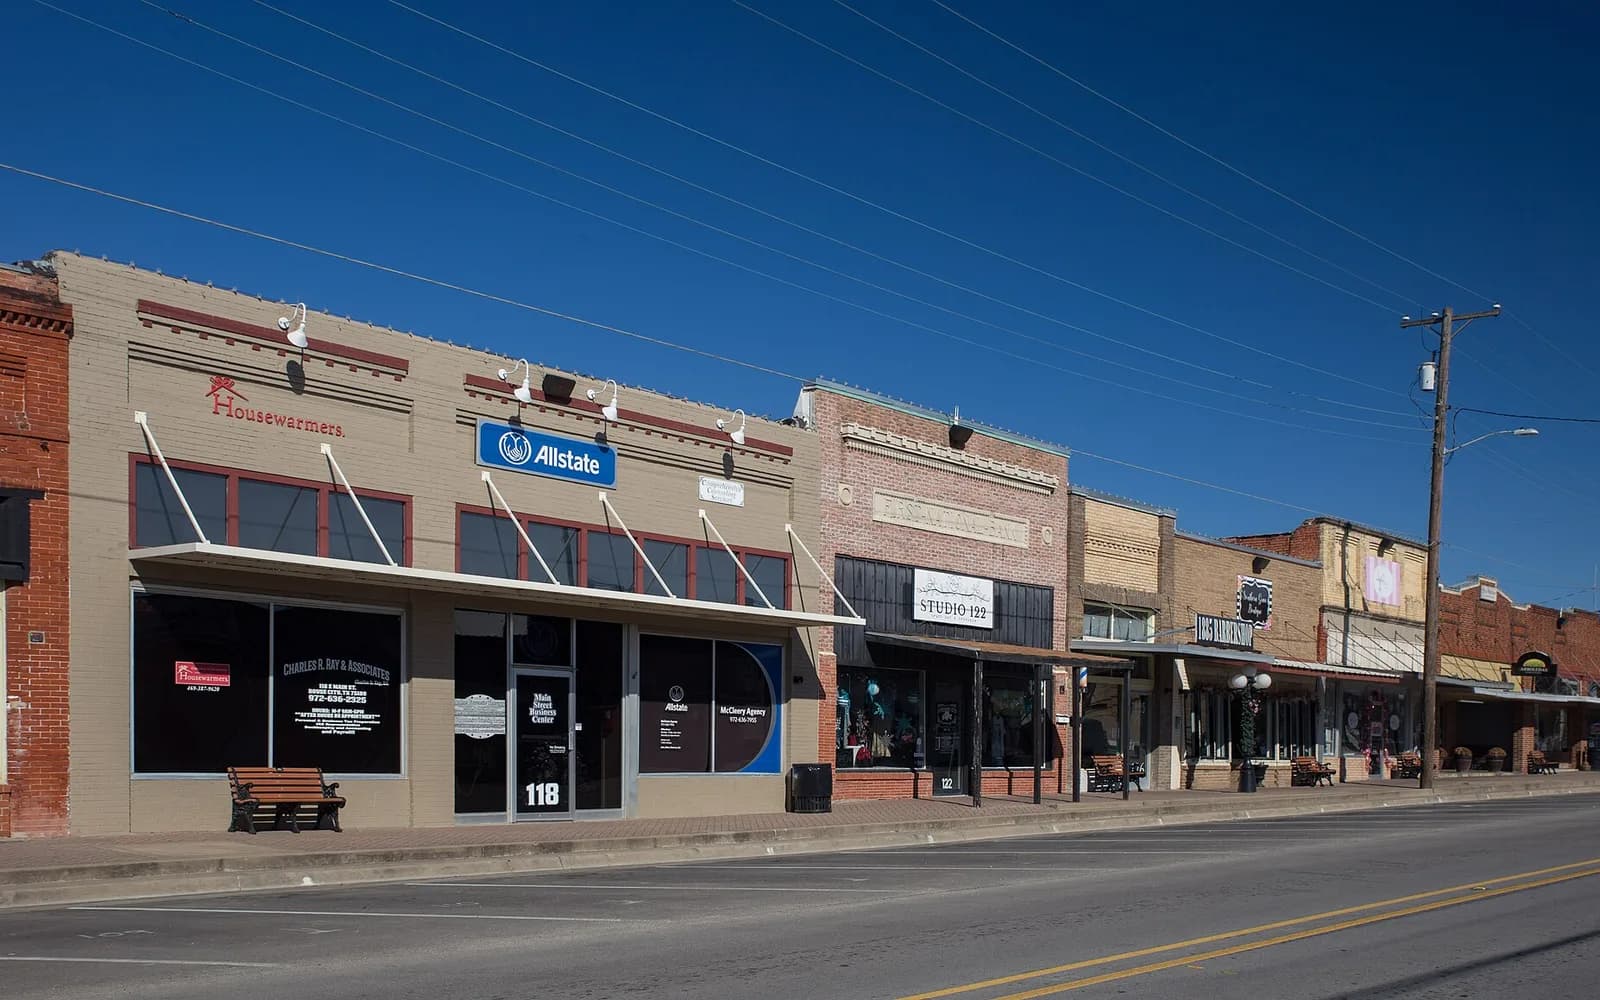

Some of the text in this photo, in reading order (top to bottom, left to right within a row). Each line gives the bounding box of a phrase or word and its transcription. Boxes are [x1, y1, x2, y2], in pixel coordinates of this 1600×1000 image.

[533, 445, 600, 475] Allstate
[920, 599, 966, 616] STUDIO
[970, 605, 987, 619] 122
[283, 658, 391, 681] CHARLES R. RAY & ASSOCIATES
[533, 693, 552, 702] Main
[532, 701, 552, 709] Street
[665, 703, 689, 712] Allstate
[529, 707, 557, 716] Business
[720, 706, 766, 717] McCleery Agency
[531, 716, 555, 724] Center
[941, 777, 953, 789] 122
[526, 782, 560, 806] 118
